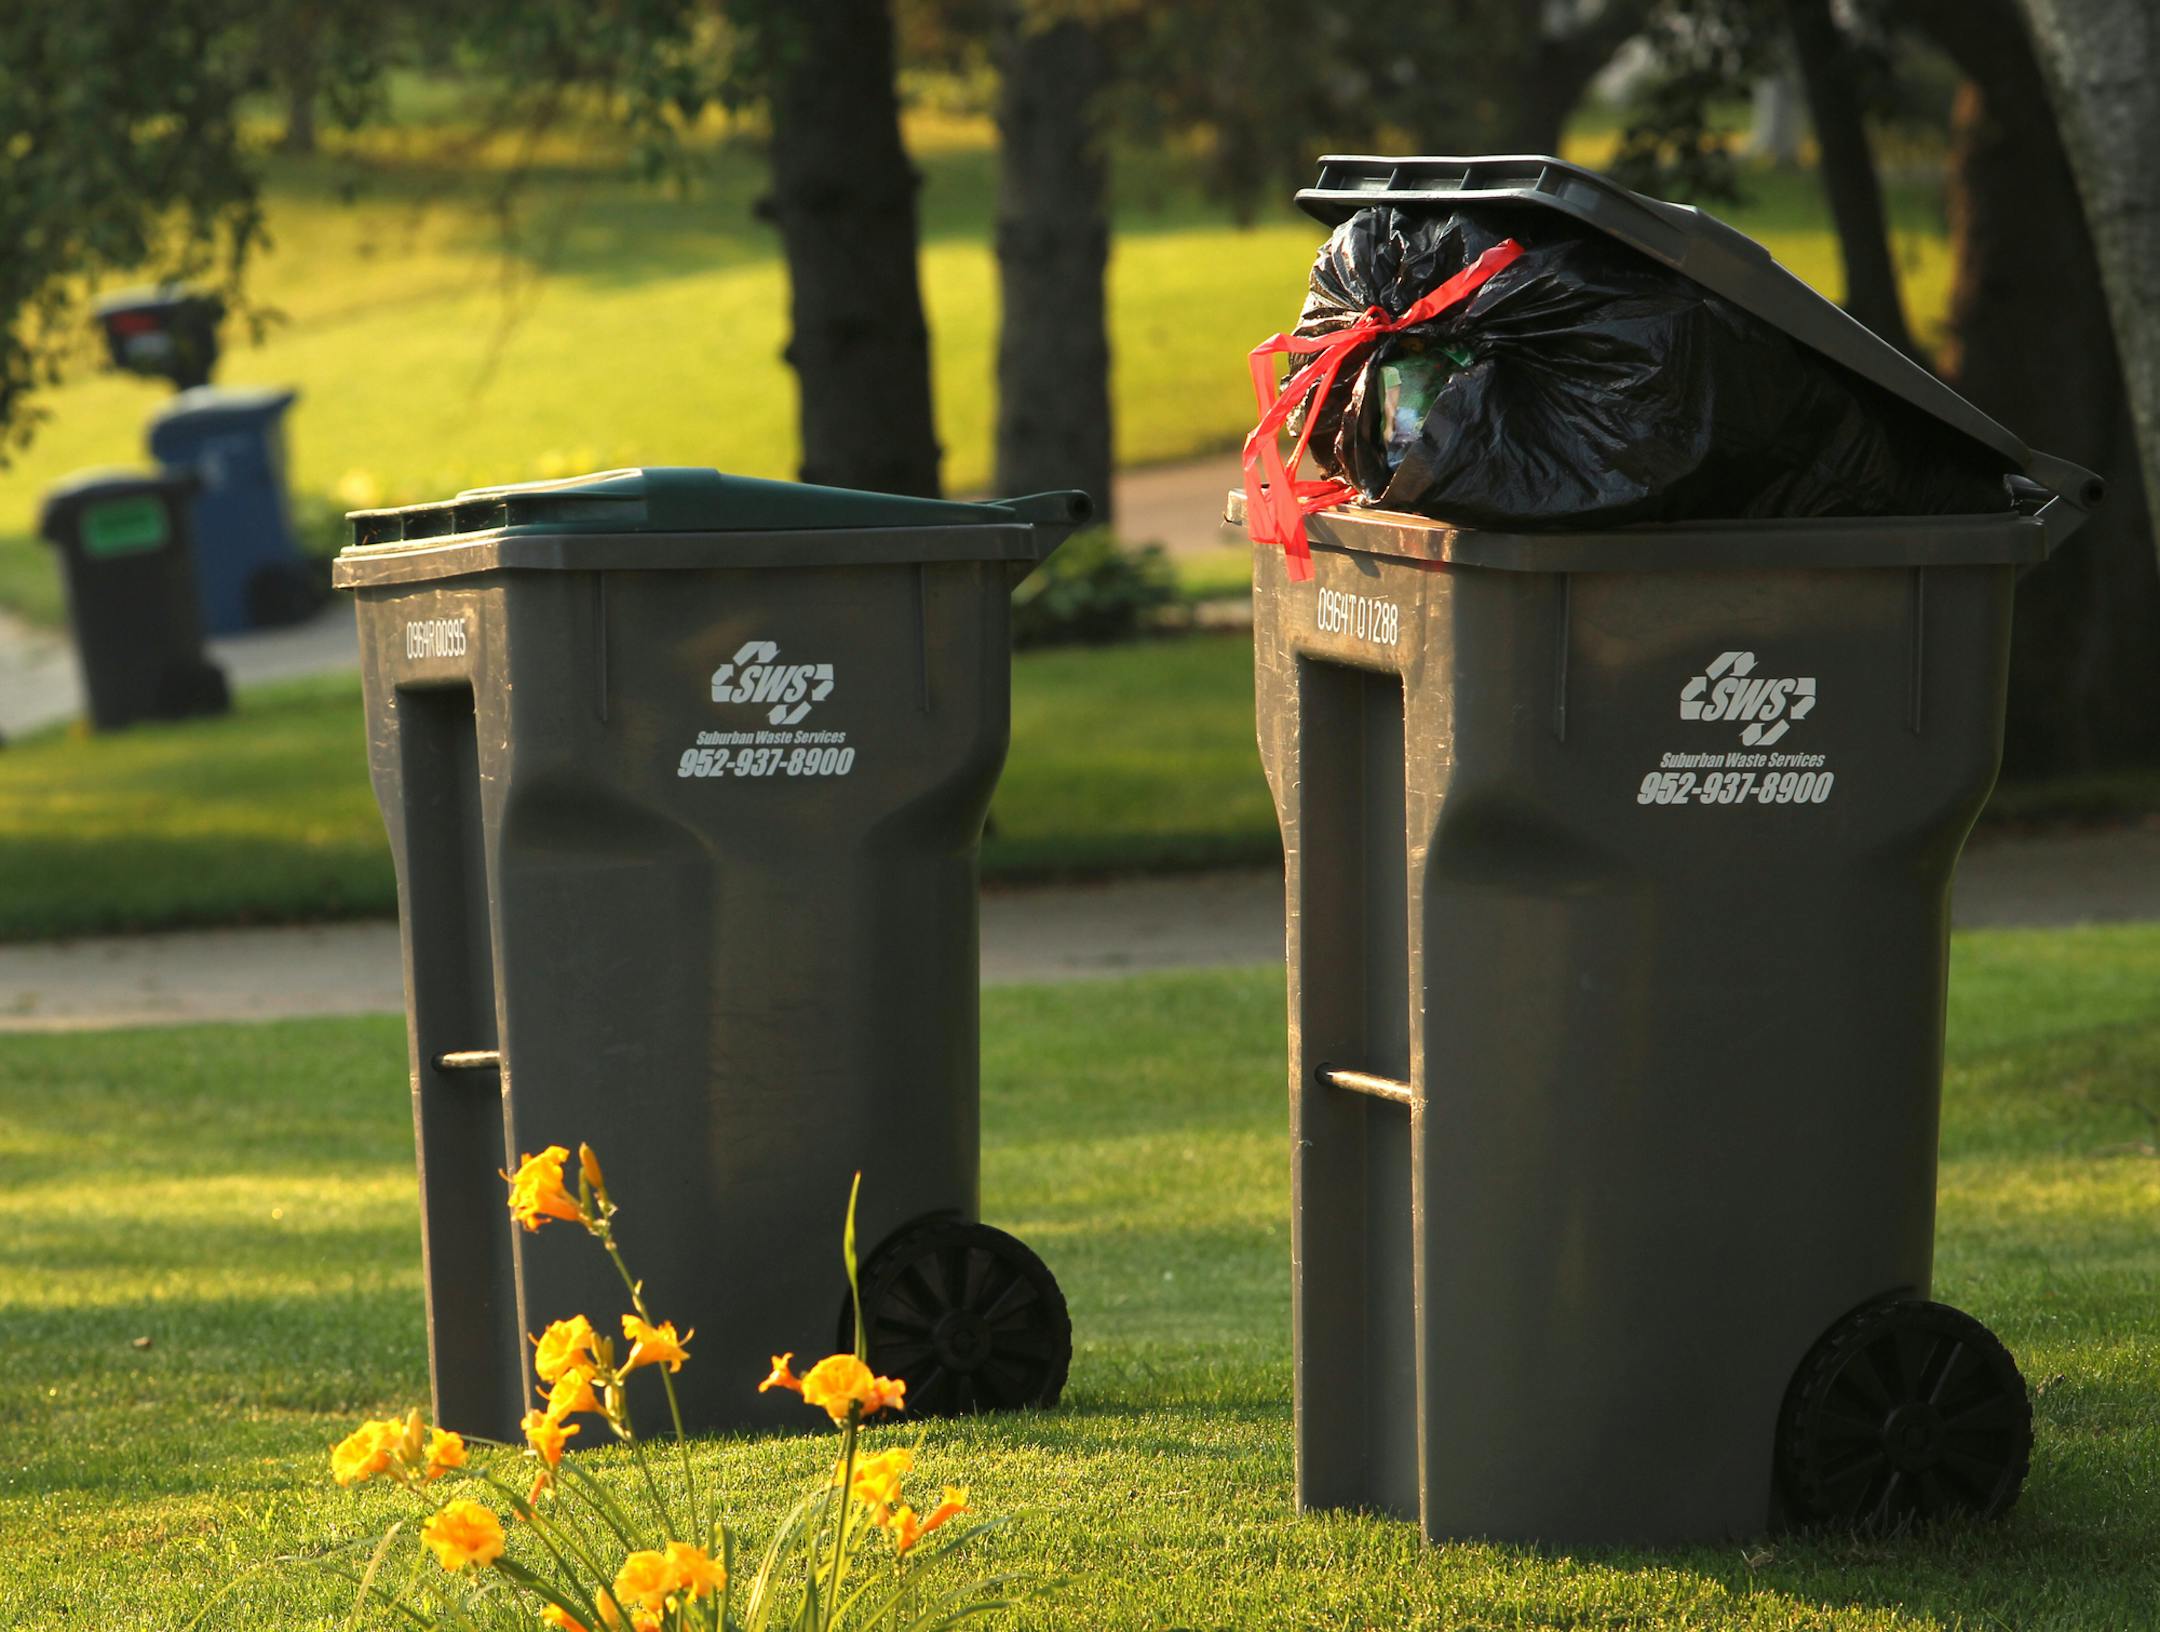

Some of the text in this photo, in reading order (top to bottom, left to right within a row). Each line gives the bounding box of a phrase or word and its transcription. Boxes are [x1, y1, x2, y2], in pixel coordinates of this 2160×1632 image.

[1317, 586, 1399, 646] 0964T01288
[731, 664, 815, 704] SWS
[1701, 677, 1796, 722] SWS
[696, 729, 847, 746] Suburban Waste Services
[677, 747, 855, 778] 952-937-8900
[1660, 752, 1826, 768] Suburban Waste Services
[1637, 772, 1835, 805] 952-937-8900
